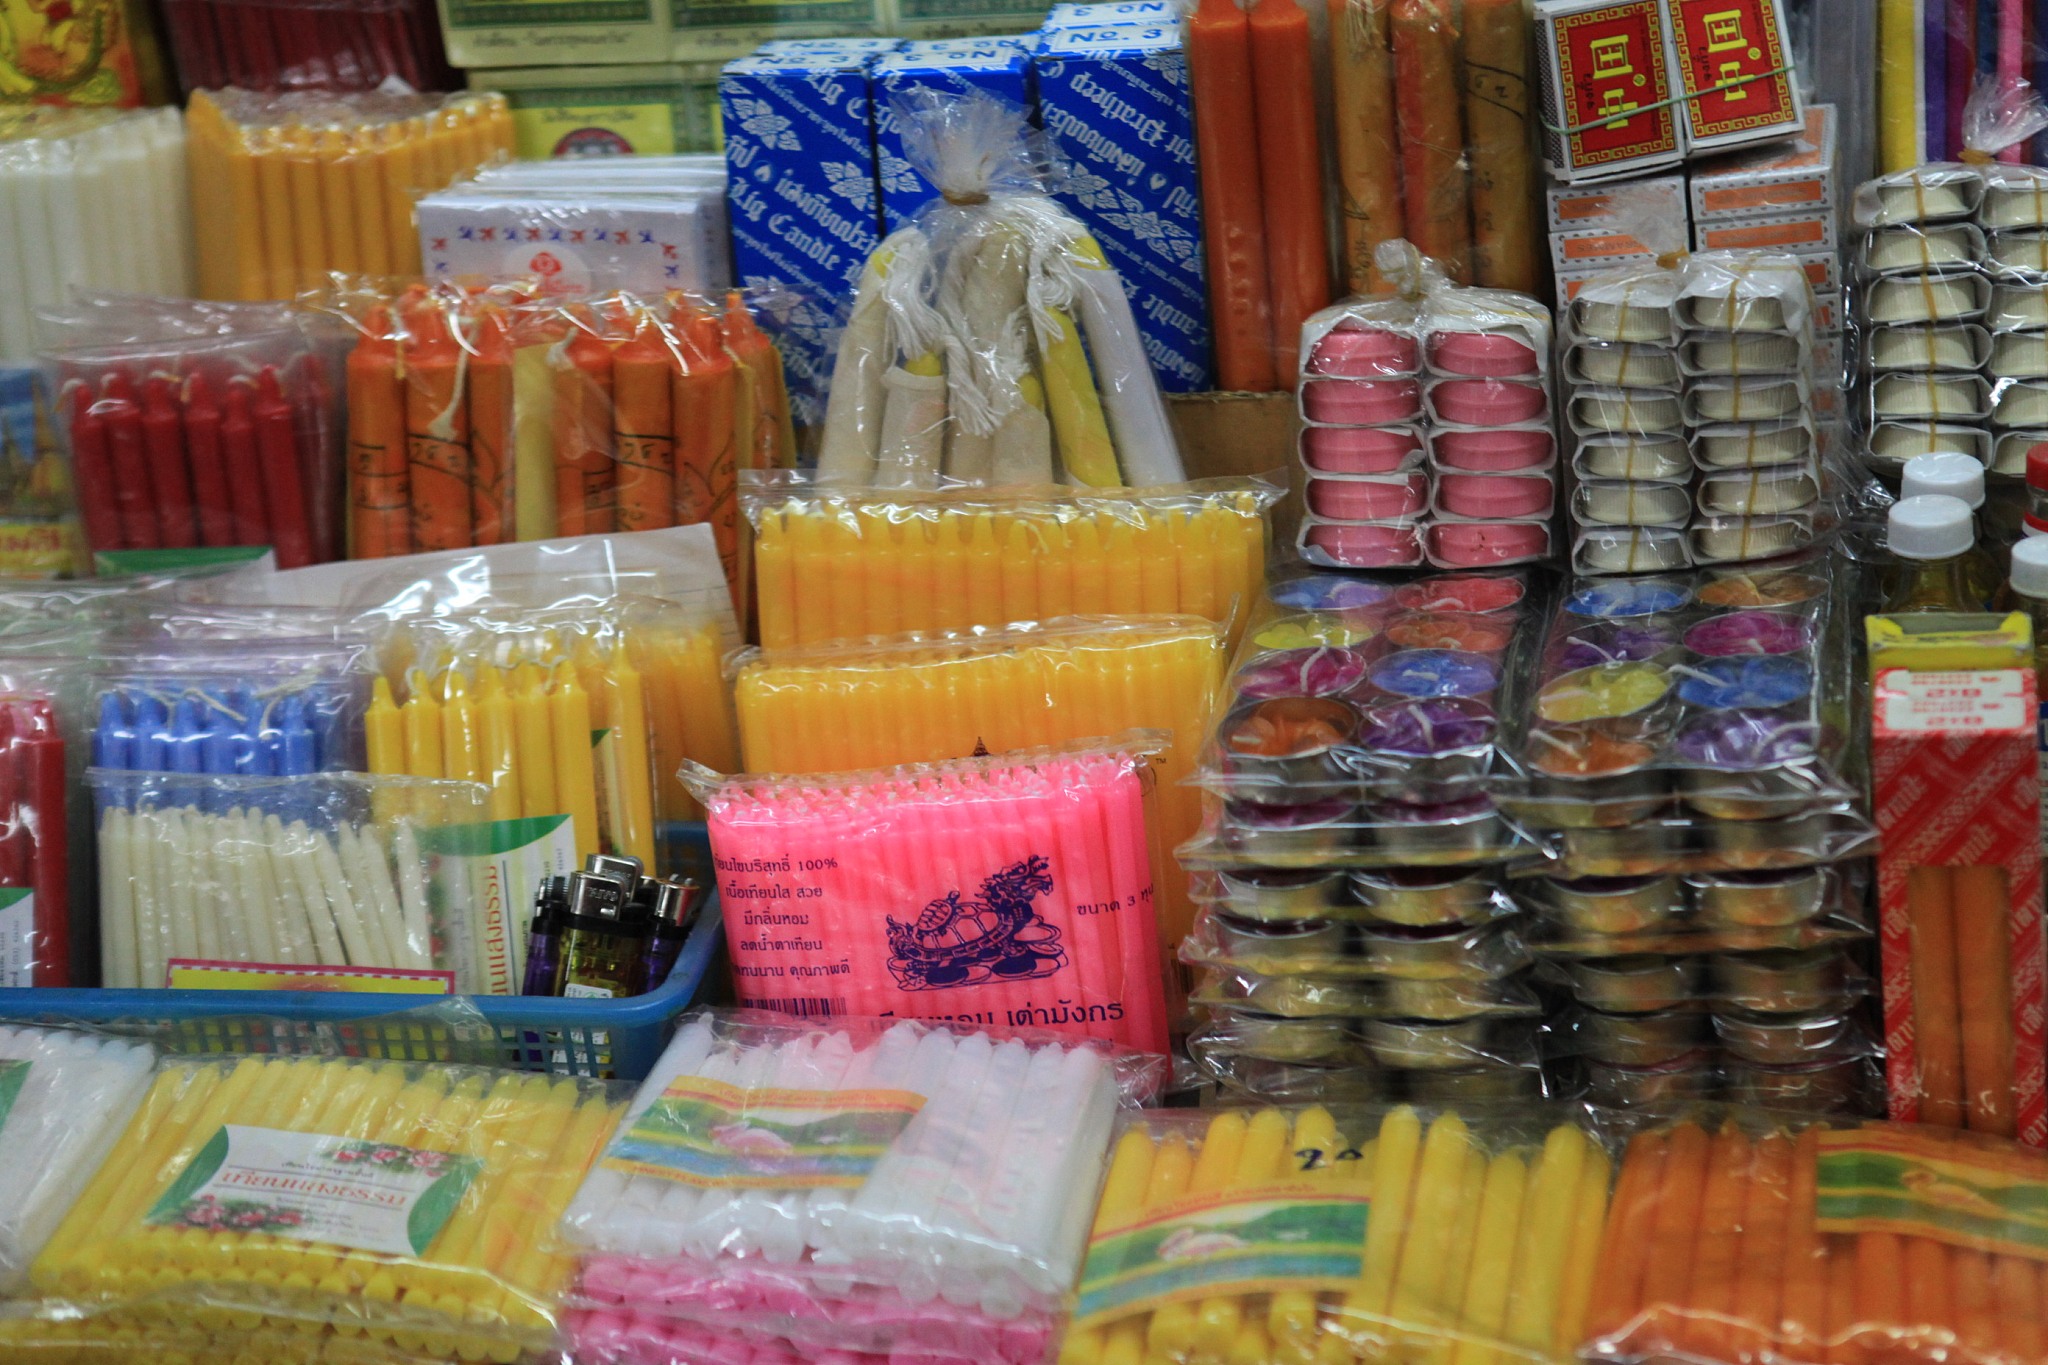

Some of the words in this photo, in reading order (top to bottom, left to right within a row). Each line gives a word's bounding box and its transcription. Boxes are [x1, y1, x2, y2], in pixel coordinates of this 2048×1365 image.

[1142, 28, 1163, 39] 3
[1590, 34, 1640, 131] 中国
[1069, 71, 1169, 147] Pratheep
[767, 212, 841, 271] Candle
[798, 857, 838, 872] 100%
[796, 886, 823, 899] สวย
[743, 905, 809, 926] มีกลิ่นหอม
[1076, 900, 1121, 916] ขนาด
[1126, 895, 1136, 907] 3
[740, 933, 823, 951] ลดน้ำตาเทียน
[789, 958, 851, 981] คุณภาพดี
[1006, 1000, 1125, 1028] เต่ามังกร
[220, 1170, 409, 1207] เทียนแสงธรรม
